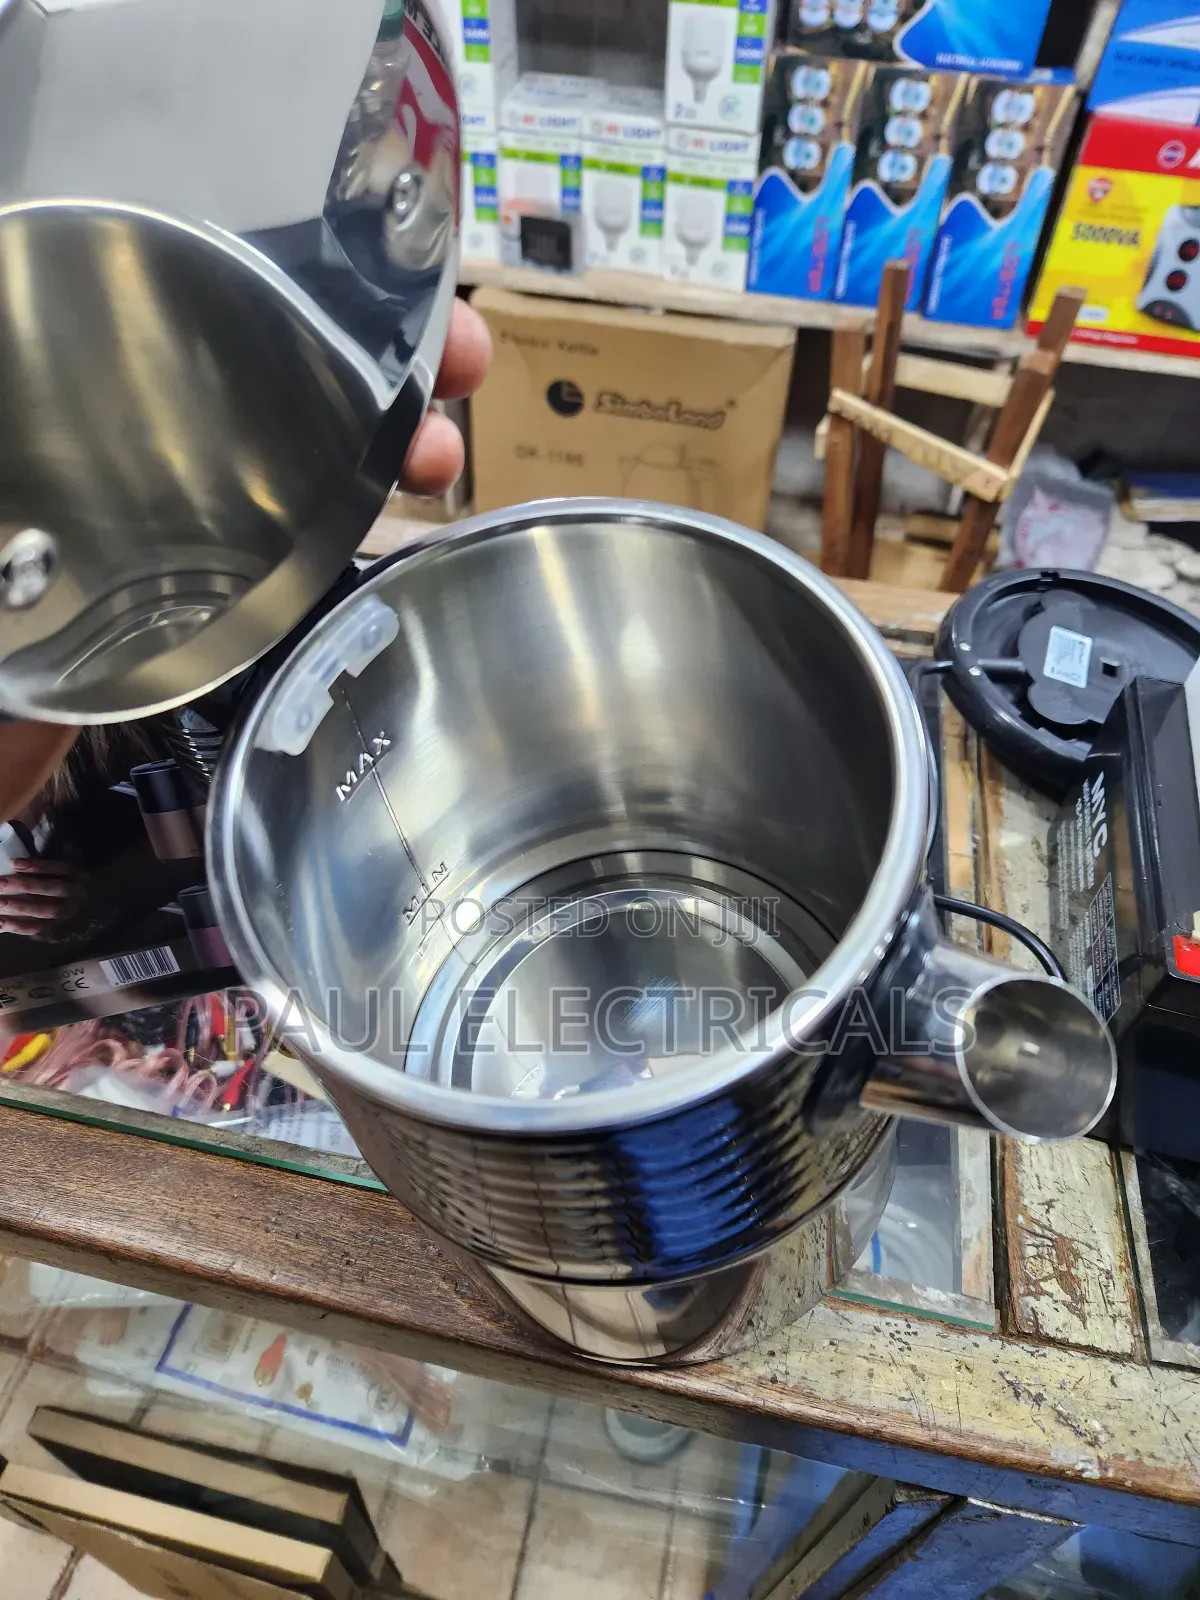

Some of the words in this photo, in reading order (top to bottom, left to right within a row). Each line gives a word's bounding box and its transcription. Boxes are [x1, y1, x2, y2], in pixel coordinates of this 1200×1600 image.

[335, 731, 392, 802] MAX
[1091, 771, 1108, 858] MYC
[402, 861, 448, 924] MIN
